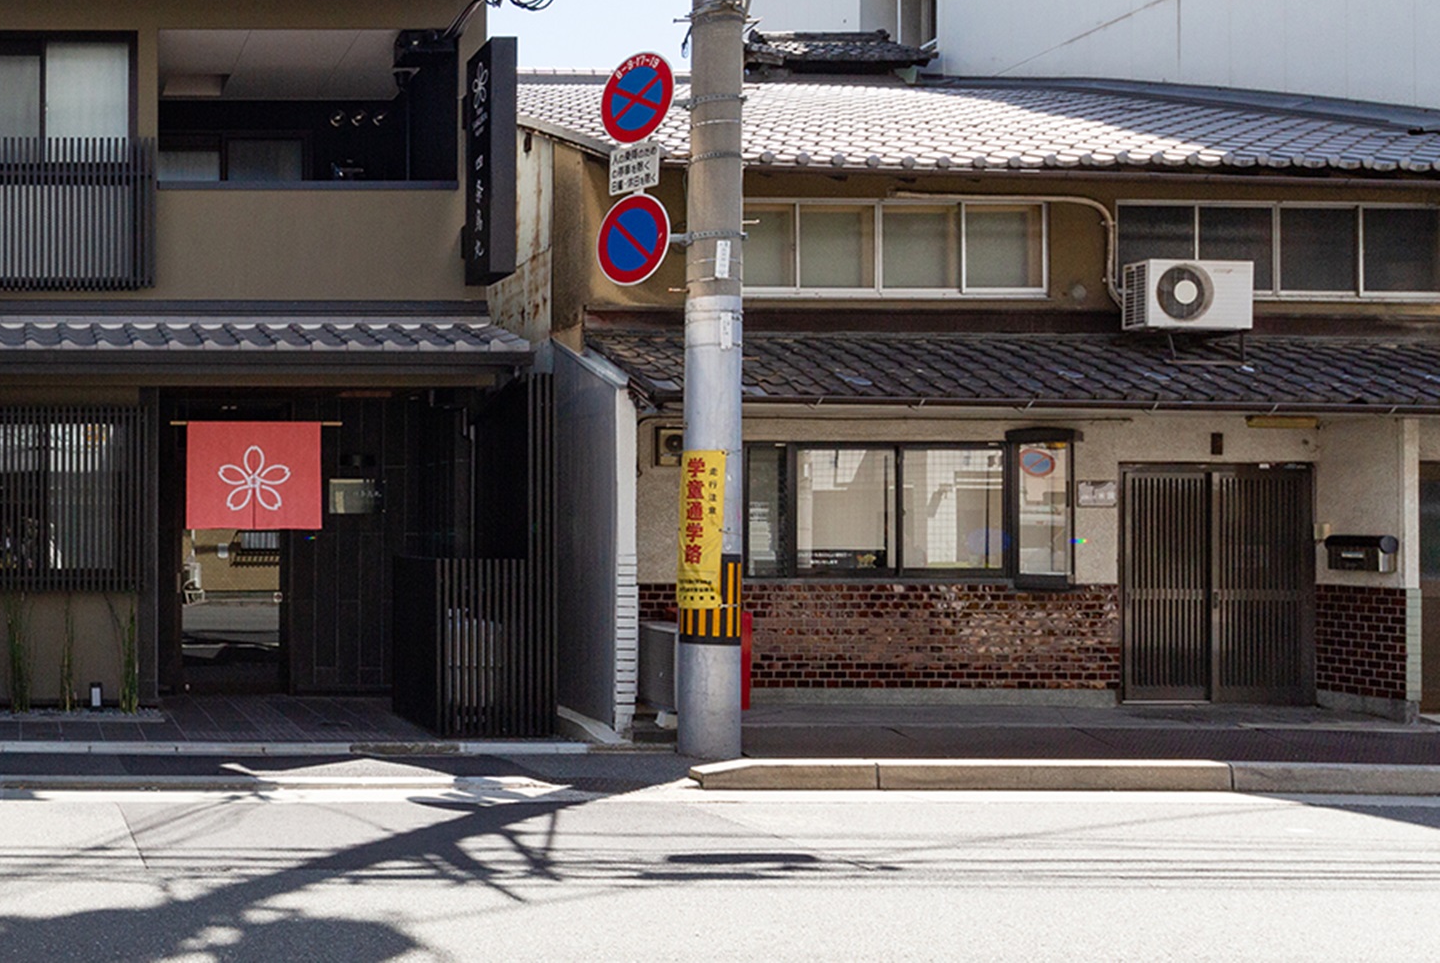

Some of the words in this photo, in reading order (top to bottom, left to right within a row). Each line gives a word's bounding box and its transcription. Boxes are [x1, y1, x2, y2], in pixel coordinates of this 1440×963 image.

[684, 457, 706, 565] 学童通学路
